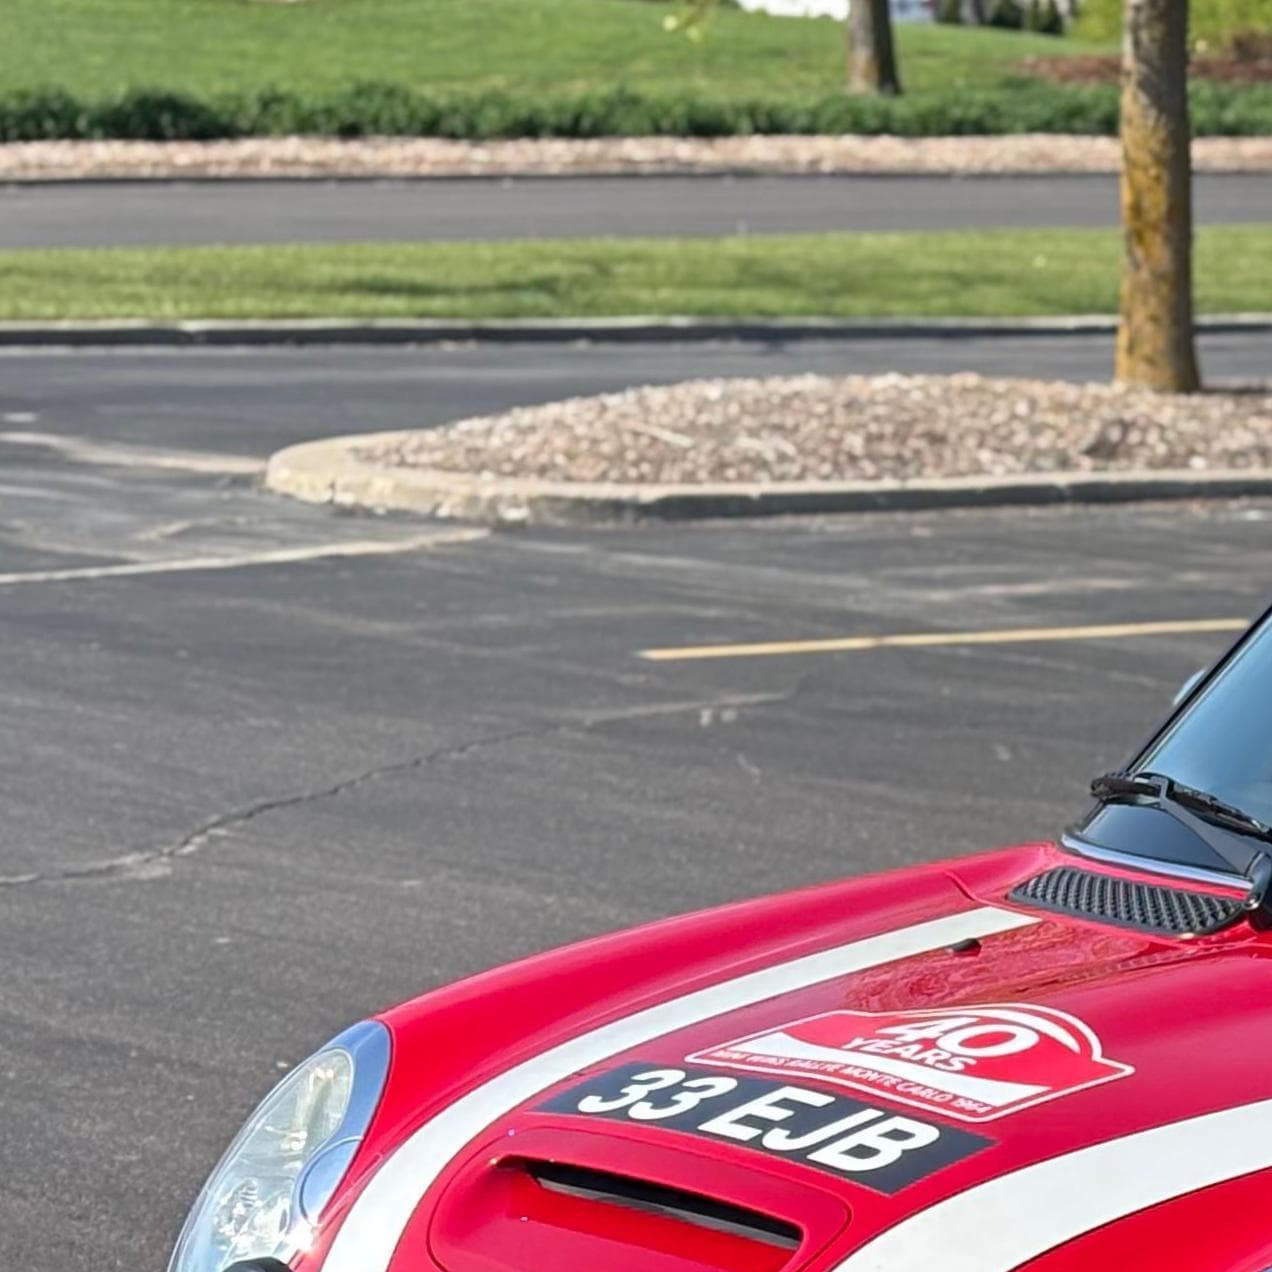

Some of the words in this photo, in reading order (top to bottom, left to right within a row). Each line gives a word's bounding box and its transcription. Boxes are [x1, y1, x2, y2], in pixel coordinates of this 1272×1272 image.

[841, 1037, 977, 1071] YEARS
[875, 1016, 1040, 1057] 40
[841, 1065, 900, 1086] MONTE
[896, 1077, 950, 1101] CARLO
[578, 1069, 738, 1120] 33
[697, 1085, 941, 1172] EJB
